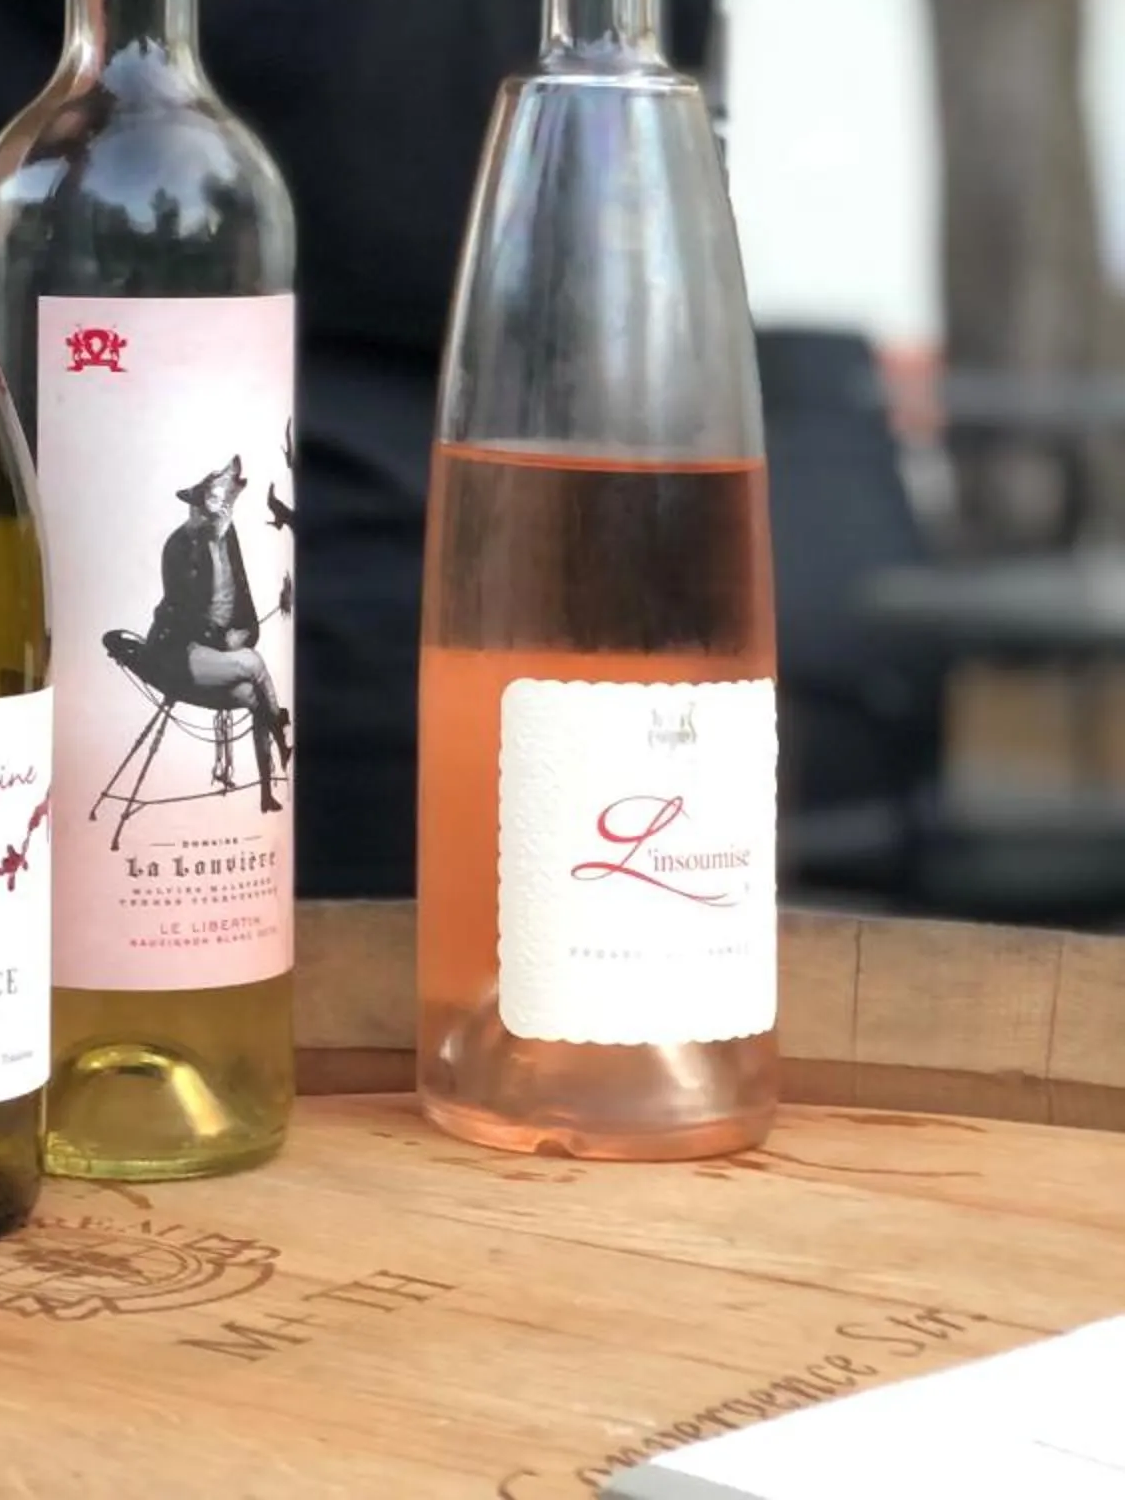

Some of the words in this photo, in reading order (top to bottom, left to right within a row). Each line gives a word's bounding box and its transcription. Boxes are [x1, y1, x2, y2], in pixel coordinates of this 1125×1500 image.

[125, 856, 160, 878] La
[172, 850, 277, 878] Louvière
[570, 795, 751, 908] L'insoumise
